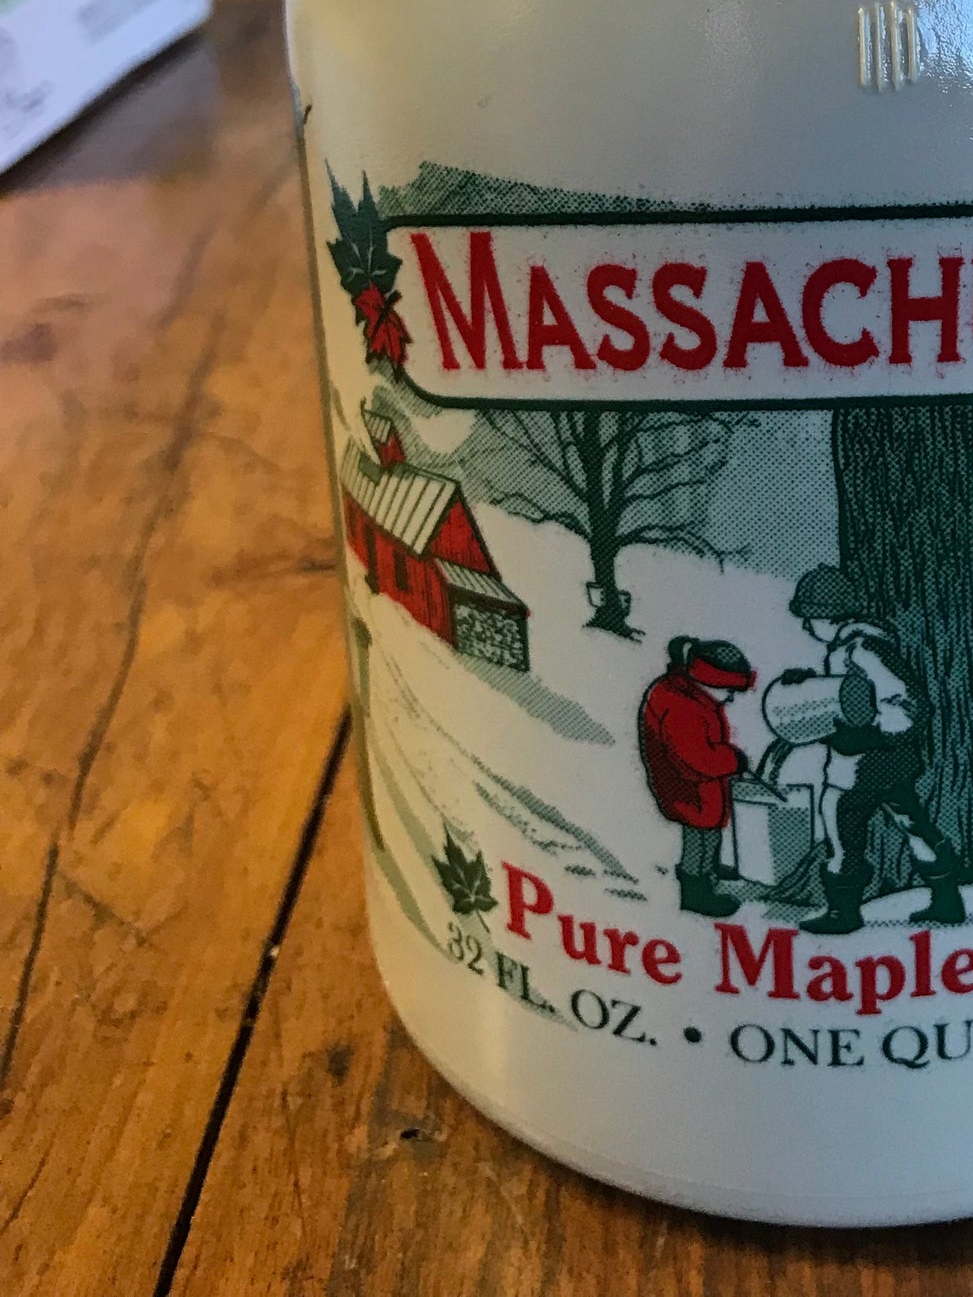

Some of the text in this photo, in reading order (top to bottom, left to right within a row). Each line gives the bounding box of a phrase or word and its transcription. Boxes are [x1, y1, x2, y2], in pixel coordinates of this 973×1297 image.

[501, 861, 683, 985] Pure
[447, 921, 485, 976] 32
[495, 950, 556, 1014] FL.
[570, 988, 659, 1046] OZ.
[729, 1023, 866, 1068] ONE
